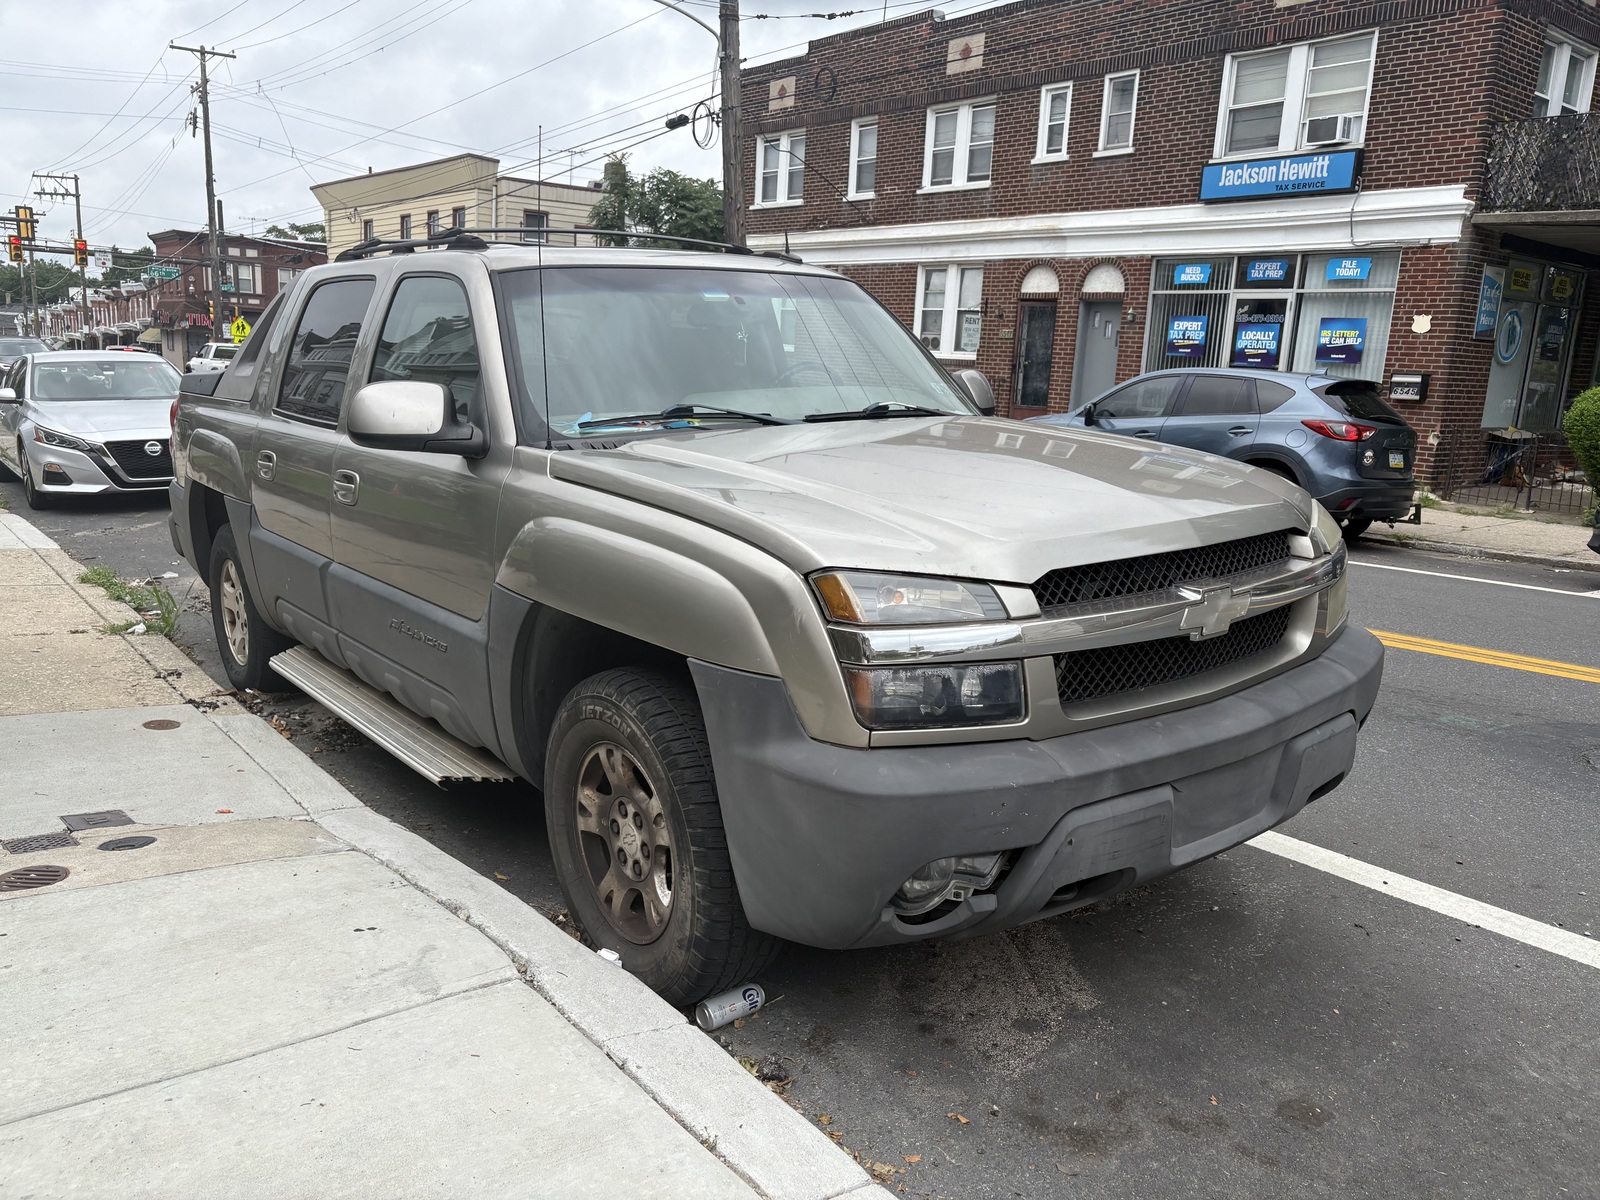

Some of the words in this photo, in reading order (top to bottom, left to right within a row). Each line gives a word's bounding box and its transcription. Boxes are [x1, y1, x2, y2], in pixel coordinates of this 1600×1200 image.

[1219, 163, 1277, 187] Jackson
[1278, 155, 1330, 181] Hewitt
[1291, 181, 1326, 190] SERVICE
[1255, 262, 1281, 270] EXPERT
[1342, 260, 1357, 268] FILE
[1185, 266, 1201, 274] NEED
[1251, 270, 1264, 278] TAX
[1264, 270, 1283, 278] PREP
[1335, 268, 1361, 276] TODAY!
[1181, 273, 1204, 281] BUCKS?
[965, 316, 980, 325] RENT
[1173, 321, 1203, 330] EXPERT
[1169, 330, 1184, 339] TAX
[1184, 330, 1205, 340] PREP
[1241, 330, 1275, 340] LOCALLY
[1332, 330, 1359, 338] LETTER?
[1237, 339, 1277, 349] OPERATED
[1345, 337, 1362, 345] HELP
[1393, 387, 1417, 395] 6545
[580, 704, 631, 738] JETZON
[742, 987, 760, 1011] Colt
